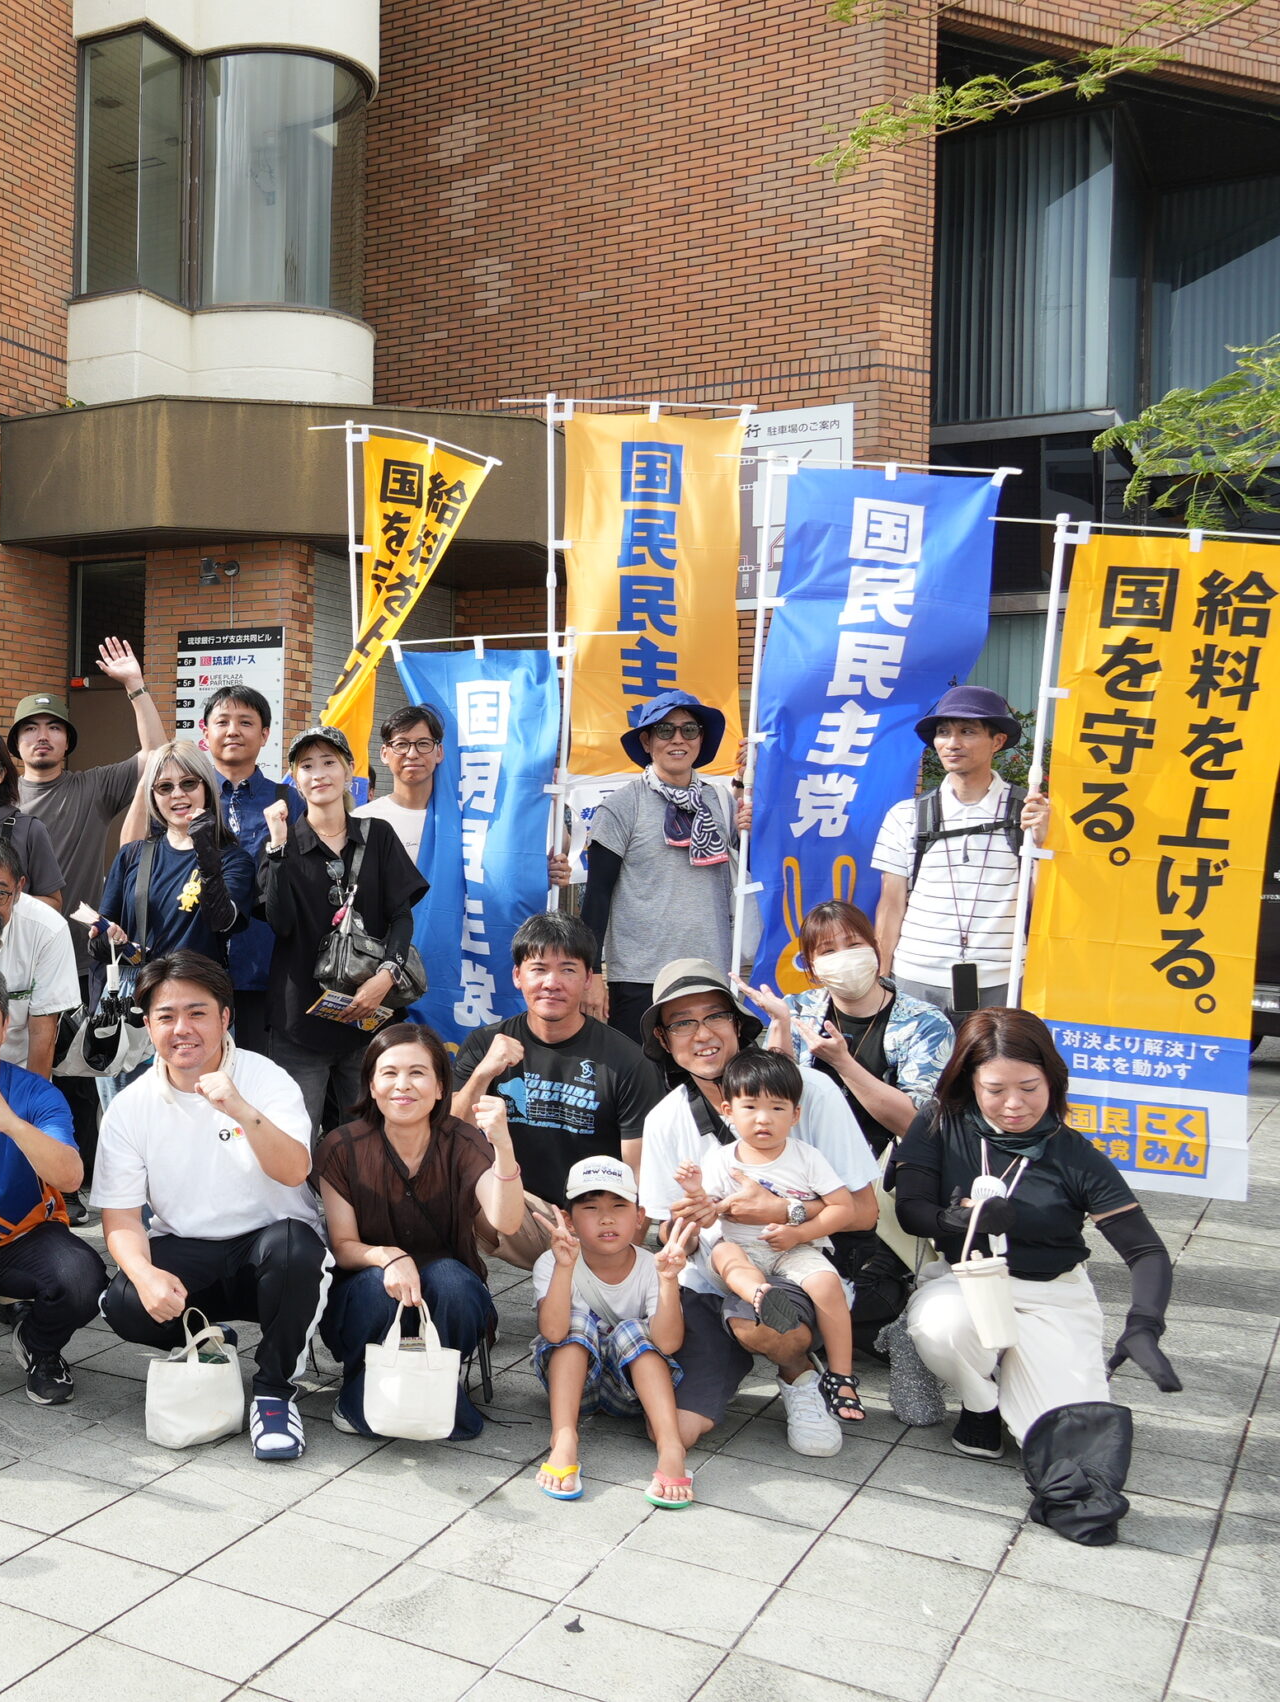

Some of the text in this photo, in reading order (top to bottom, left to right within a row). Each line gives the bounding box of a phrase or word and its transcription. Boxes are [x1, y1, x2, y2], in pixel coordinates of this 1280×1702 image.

[767, 420, 840, 436] 駐車場のご案内
[617, 441, 683, 728] 国民民主
[187, 633, 272, 646] 琉球銀行コザ支店共同ビル
[183, 658, 193, 666] 6F
[212, 654, 256, 666] 琉球リース
[789, 497, 925, 838] 国民民主党
[183, 680, 192, 688] 5F
[182, 699, 192, 707] 3F
[182, 721, 191, 729] 3F
[1069, 566, 1180, 867] 国を守る。
[1150, 568, 1279, 1014] 給料を上げる。
[1052, 1027, 1220, 1062] 「対決より解決」で
[1072, 1053, 1192, 1080] 日本を動かす
[1145, 1112, 1198, 1139] こく
[1143, 1140, 1200, 1168] みん
[602, 1169, 623, 1177] YORK
